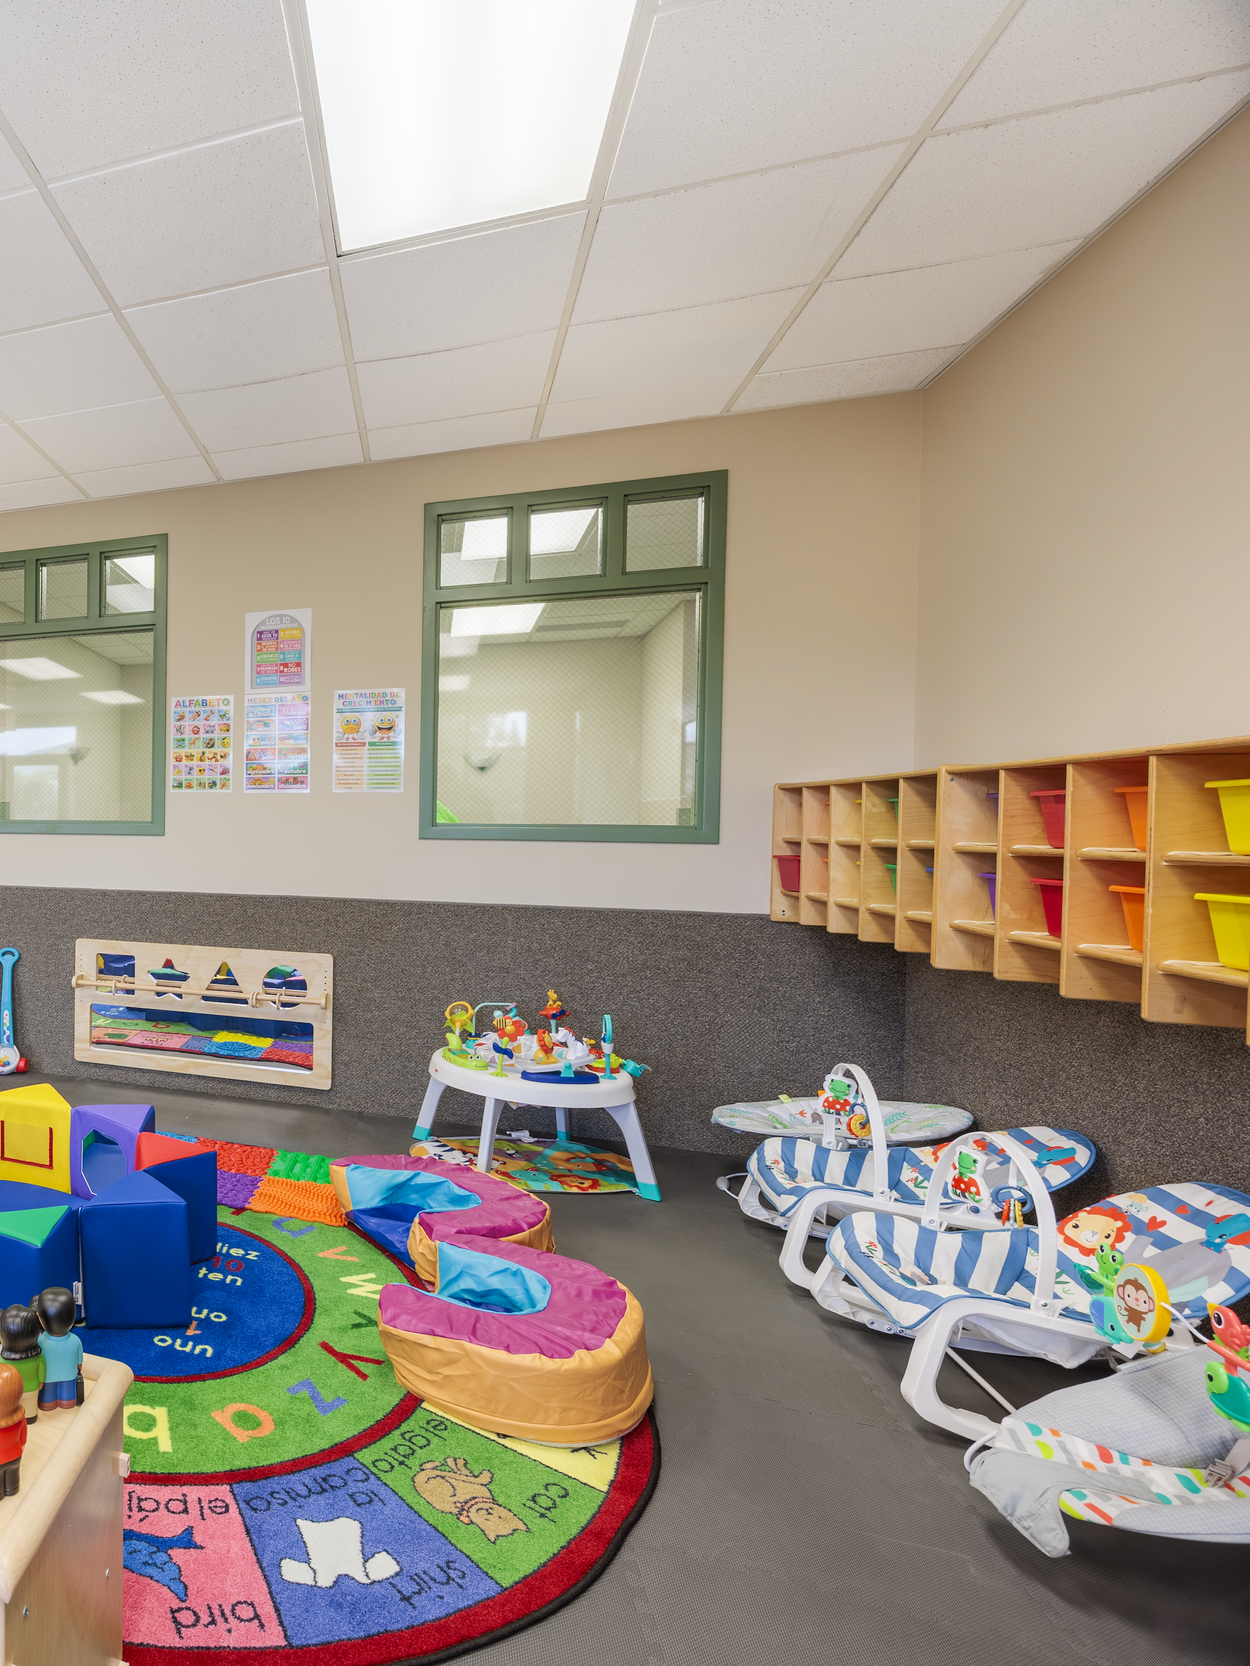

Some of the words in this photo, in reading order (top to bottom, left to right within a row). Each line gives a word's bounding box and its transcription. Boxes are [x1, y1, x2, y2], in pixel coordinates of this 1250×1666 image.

[175, 698, 230, 708] ALFABETO
[291, 694, 309, 702] AÑO
[338, 692, 387, 700] MENTALIDAD
[342, 699, 397, 707] CRECIMIENTO
[217, 1242, 261, 1260] iez
[211, 1256, 244, 1272] 10
[198, 1267, 243, 1286] ten
[191, 1306, 228, 1322] on
[153, 1335, 213, 1358] uno
[419, 1419, 448, 1441] el
[372, 1430, 431, 1473] gato
[244, 1467, 371, 1514] camisa
[347, 1490, 386, 1507] la
[127, 1490, 188, 1522] páj
[198, 1497, 230, 1522] el
[523, 1483, 569, 1524] cat
[387, 1559, 467, 1609] shirt
[169, 1600, 266, 1640] bird
